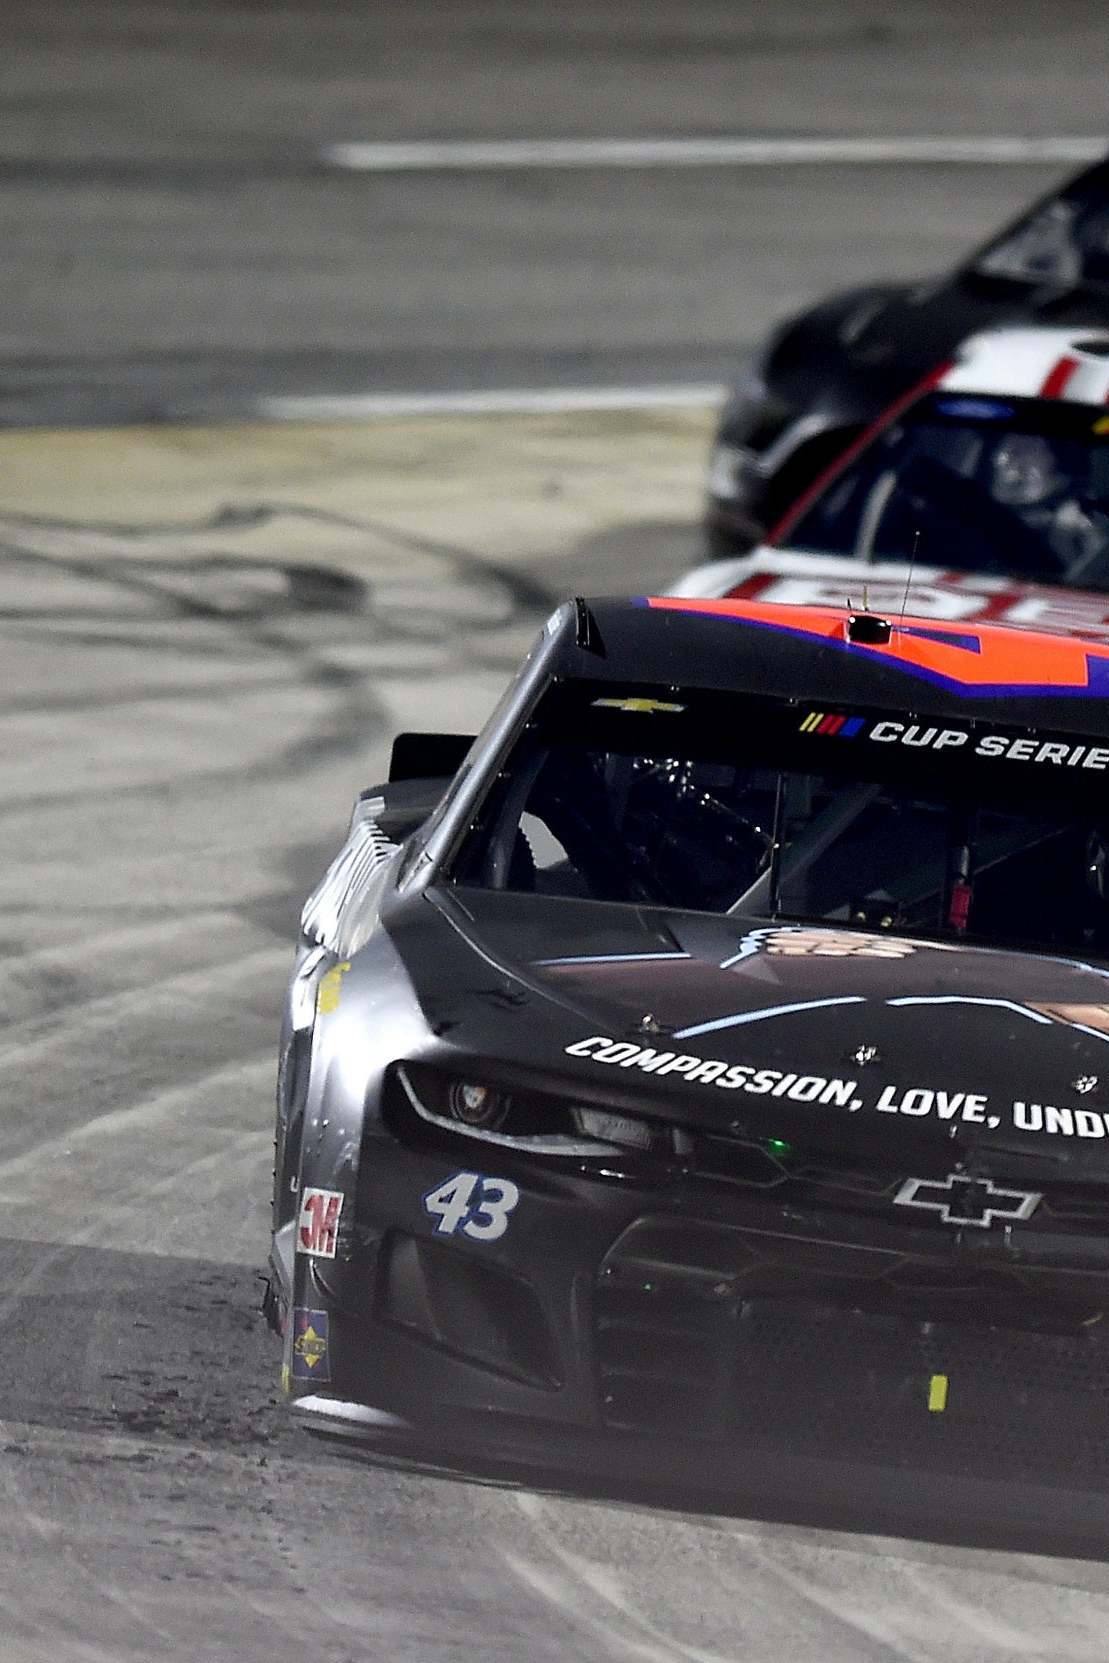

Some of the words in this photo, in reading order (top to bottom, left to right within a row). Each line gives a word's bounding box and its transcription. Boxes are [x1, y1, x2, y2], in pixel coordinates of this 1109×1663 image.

[869, 720, 969, 750] CUP
[565, 1036, 862, 1111] COMPASSION,
[875, 1086, 1000, 1129] LOVE,
[423, 1170, 521, 1243] 43
